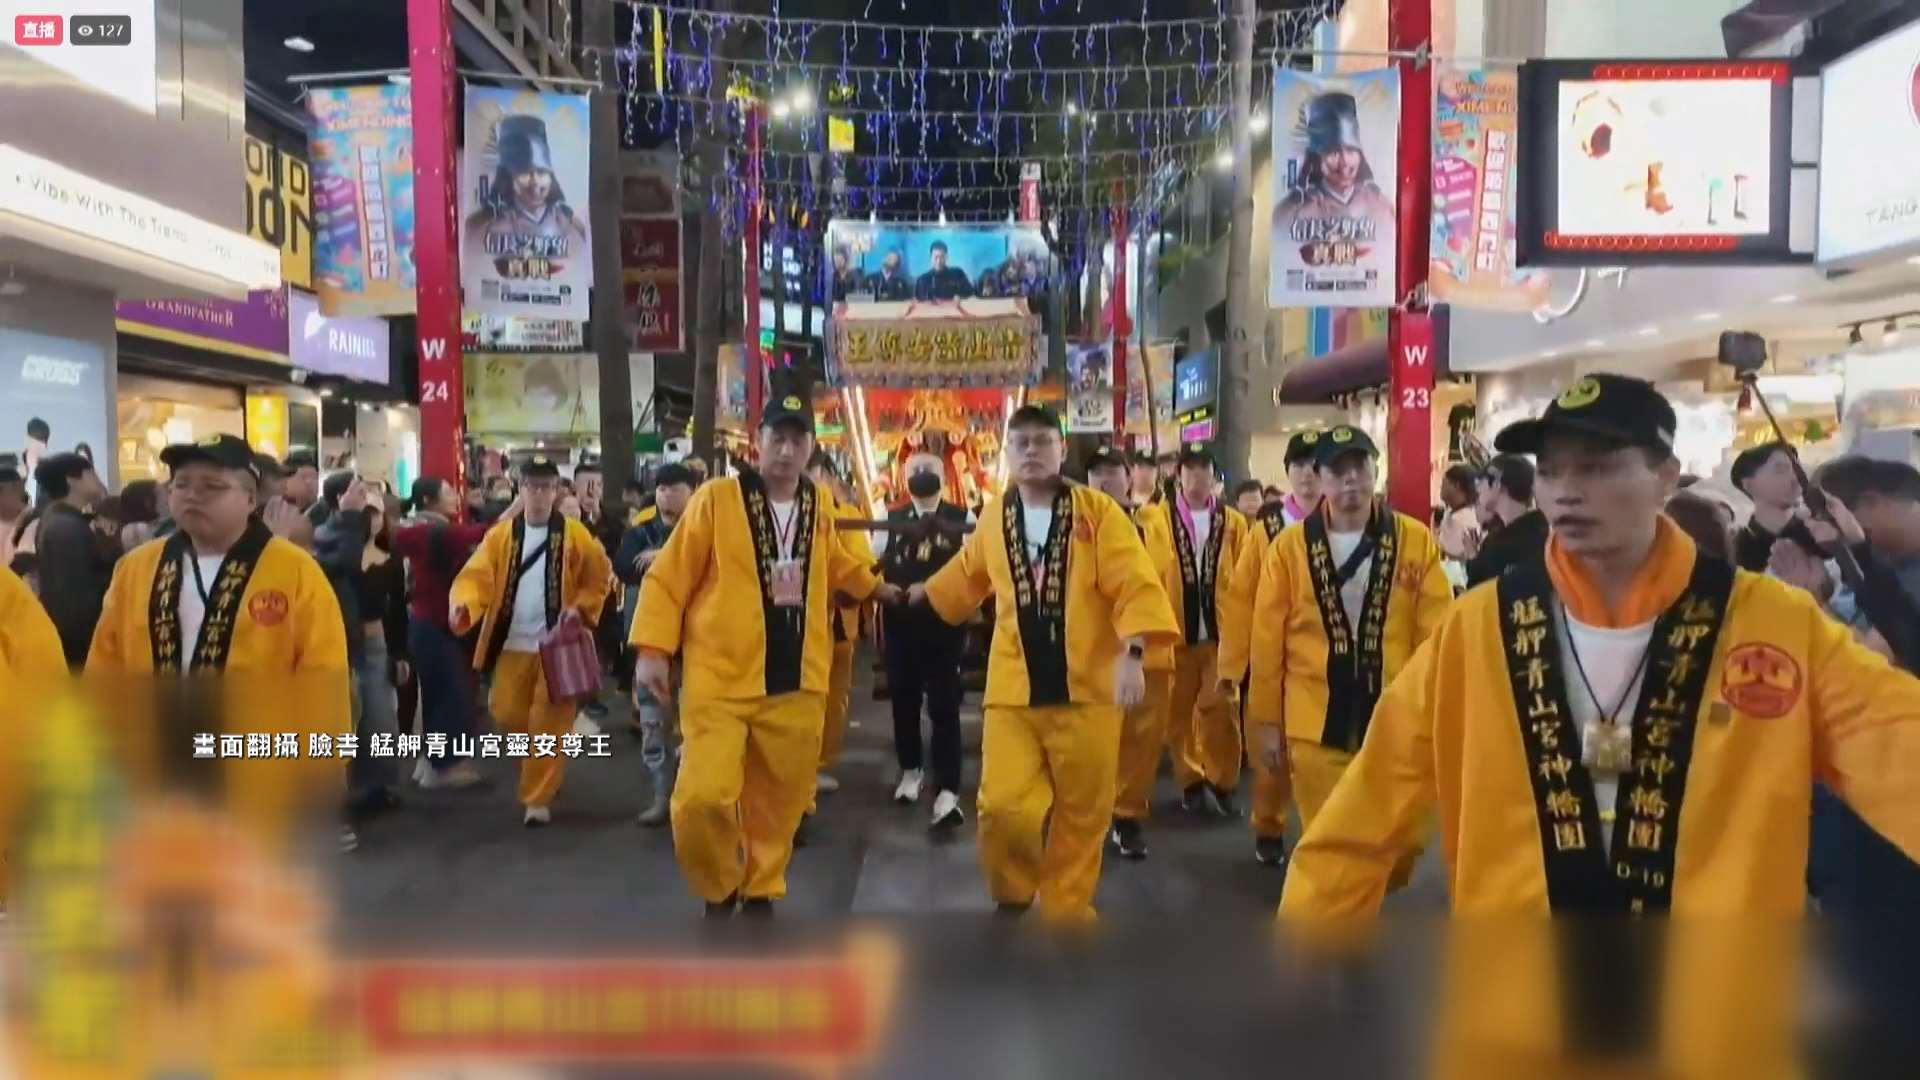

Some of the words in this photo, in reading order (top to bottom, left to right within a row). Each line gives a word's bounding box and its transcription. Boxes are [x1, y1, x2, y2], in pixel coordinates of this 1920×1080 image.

[29, 176, 69, 203] Vibe
[77, 195, 115, 217] With
[422, 337, 446, 360] W
[1404, 345, 1428, 366] W
[422, 380, 448, 402] 24
[1402, 387, 1429, 409] 23
